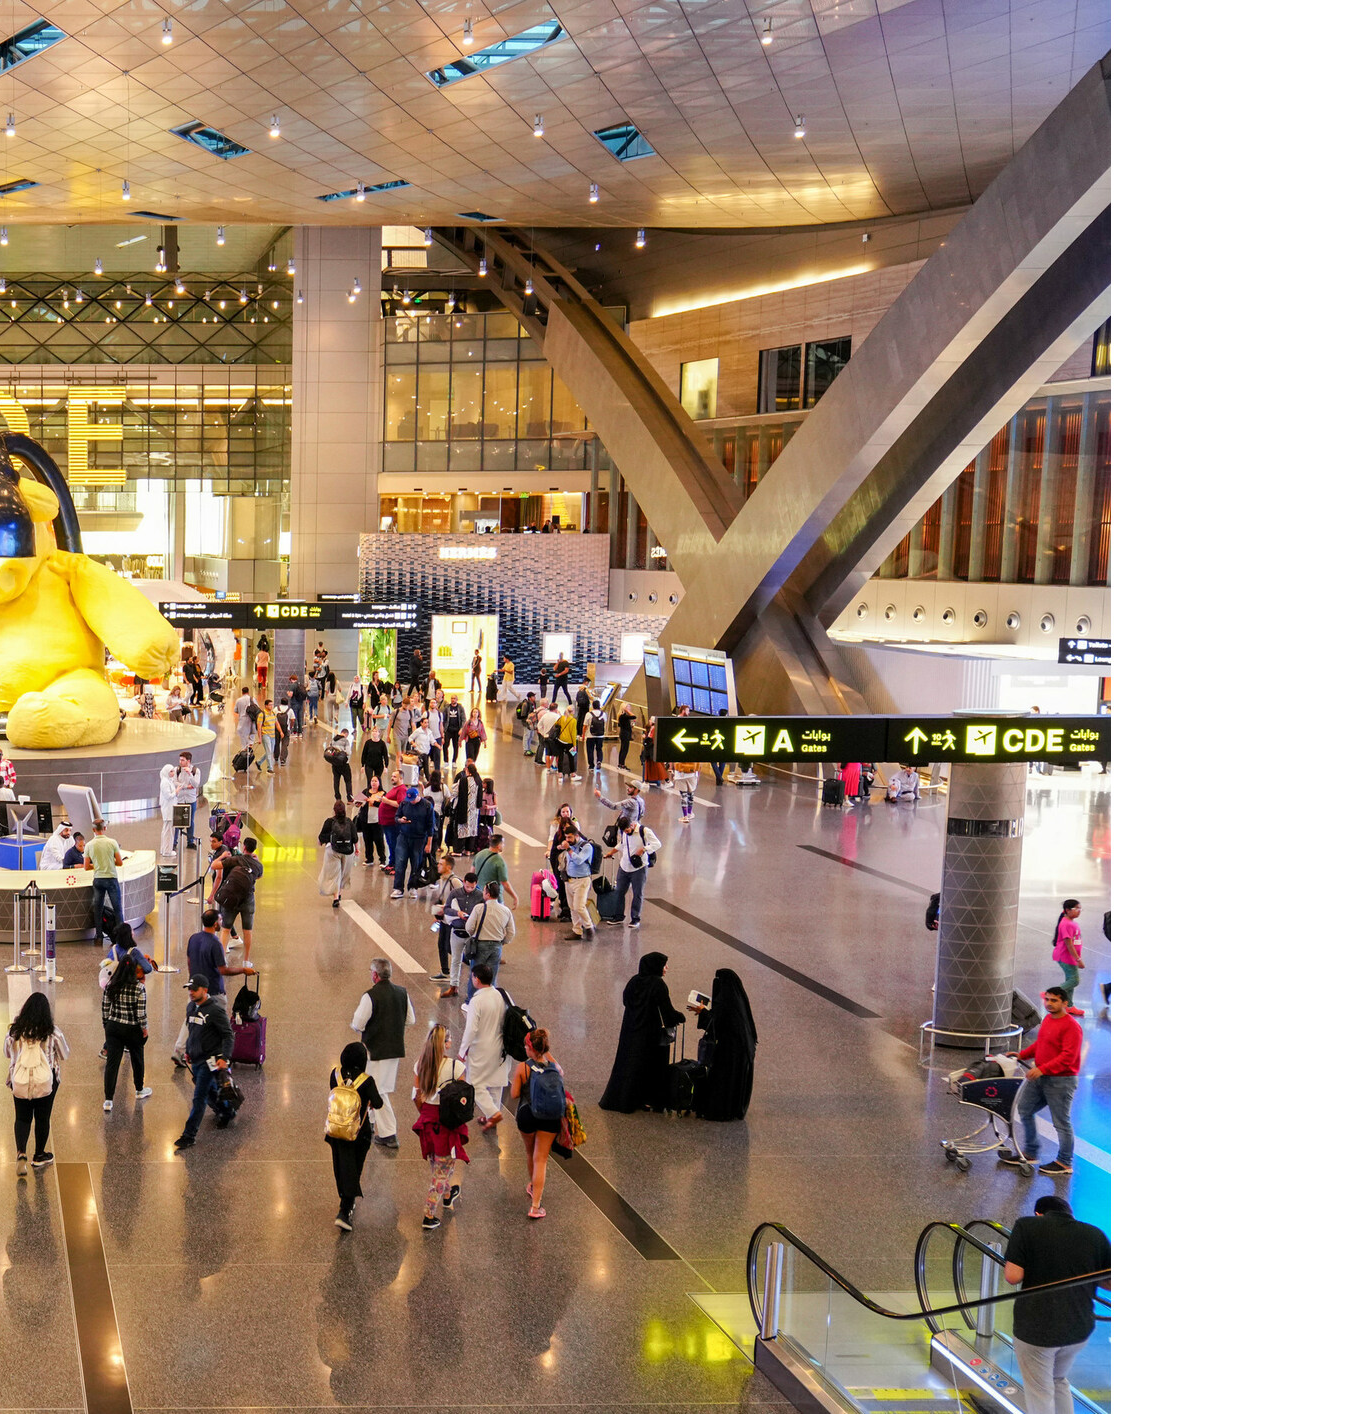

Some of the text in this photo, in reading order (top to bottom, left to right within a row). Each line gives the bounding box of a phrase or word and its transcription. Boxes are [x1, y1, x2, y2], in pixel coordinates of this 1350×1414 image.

[280, 606, 308, 618] CDE
[771, 729, 794, 752] A
[801, 729, 831, 742] بوابات
[931, 733, 942, 741] 10
[1070, 728, 1099, 741] بوابات
[1002, 729, 1065, 753] CDE
[800, 744, 827, 753] Gates
[1069, 743, 1096, 752] Gates
